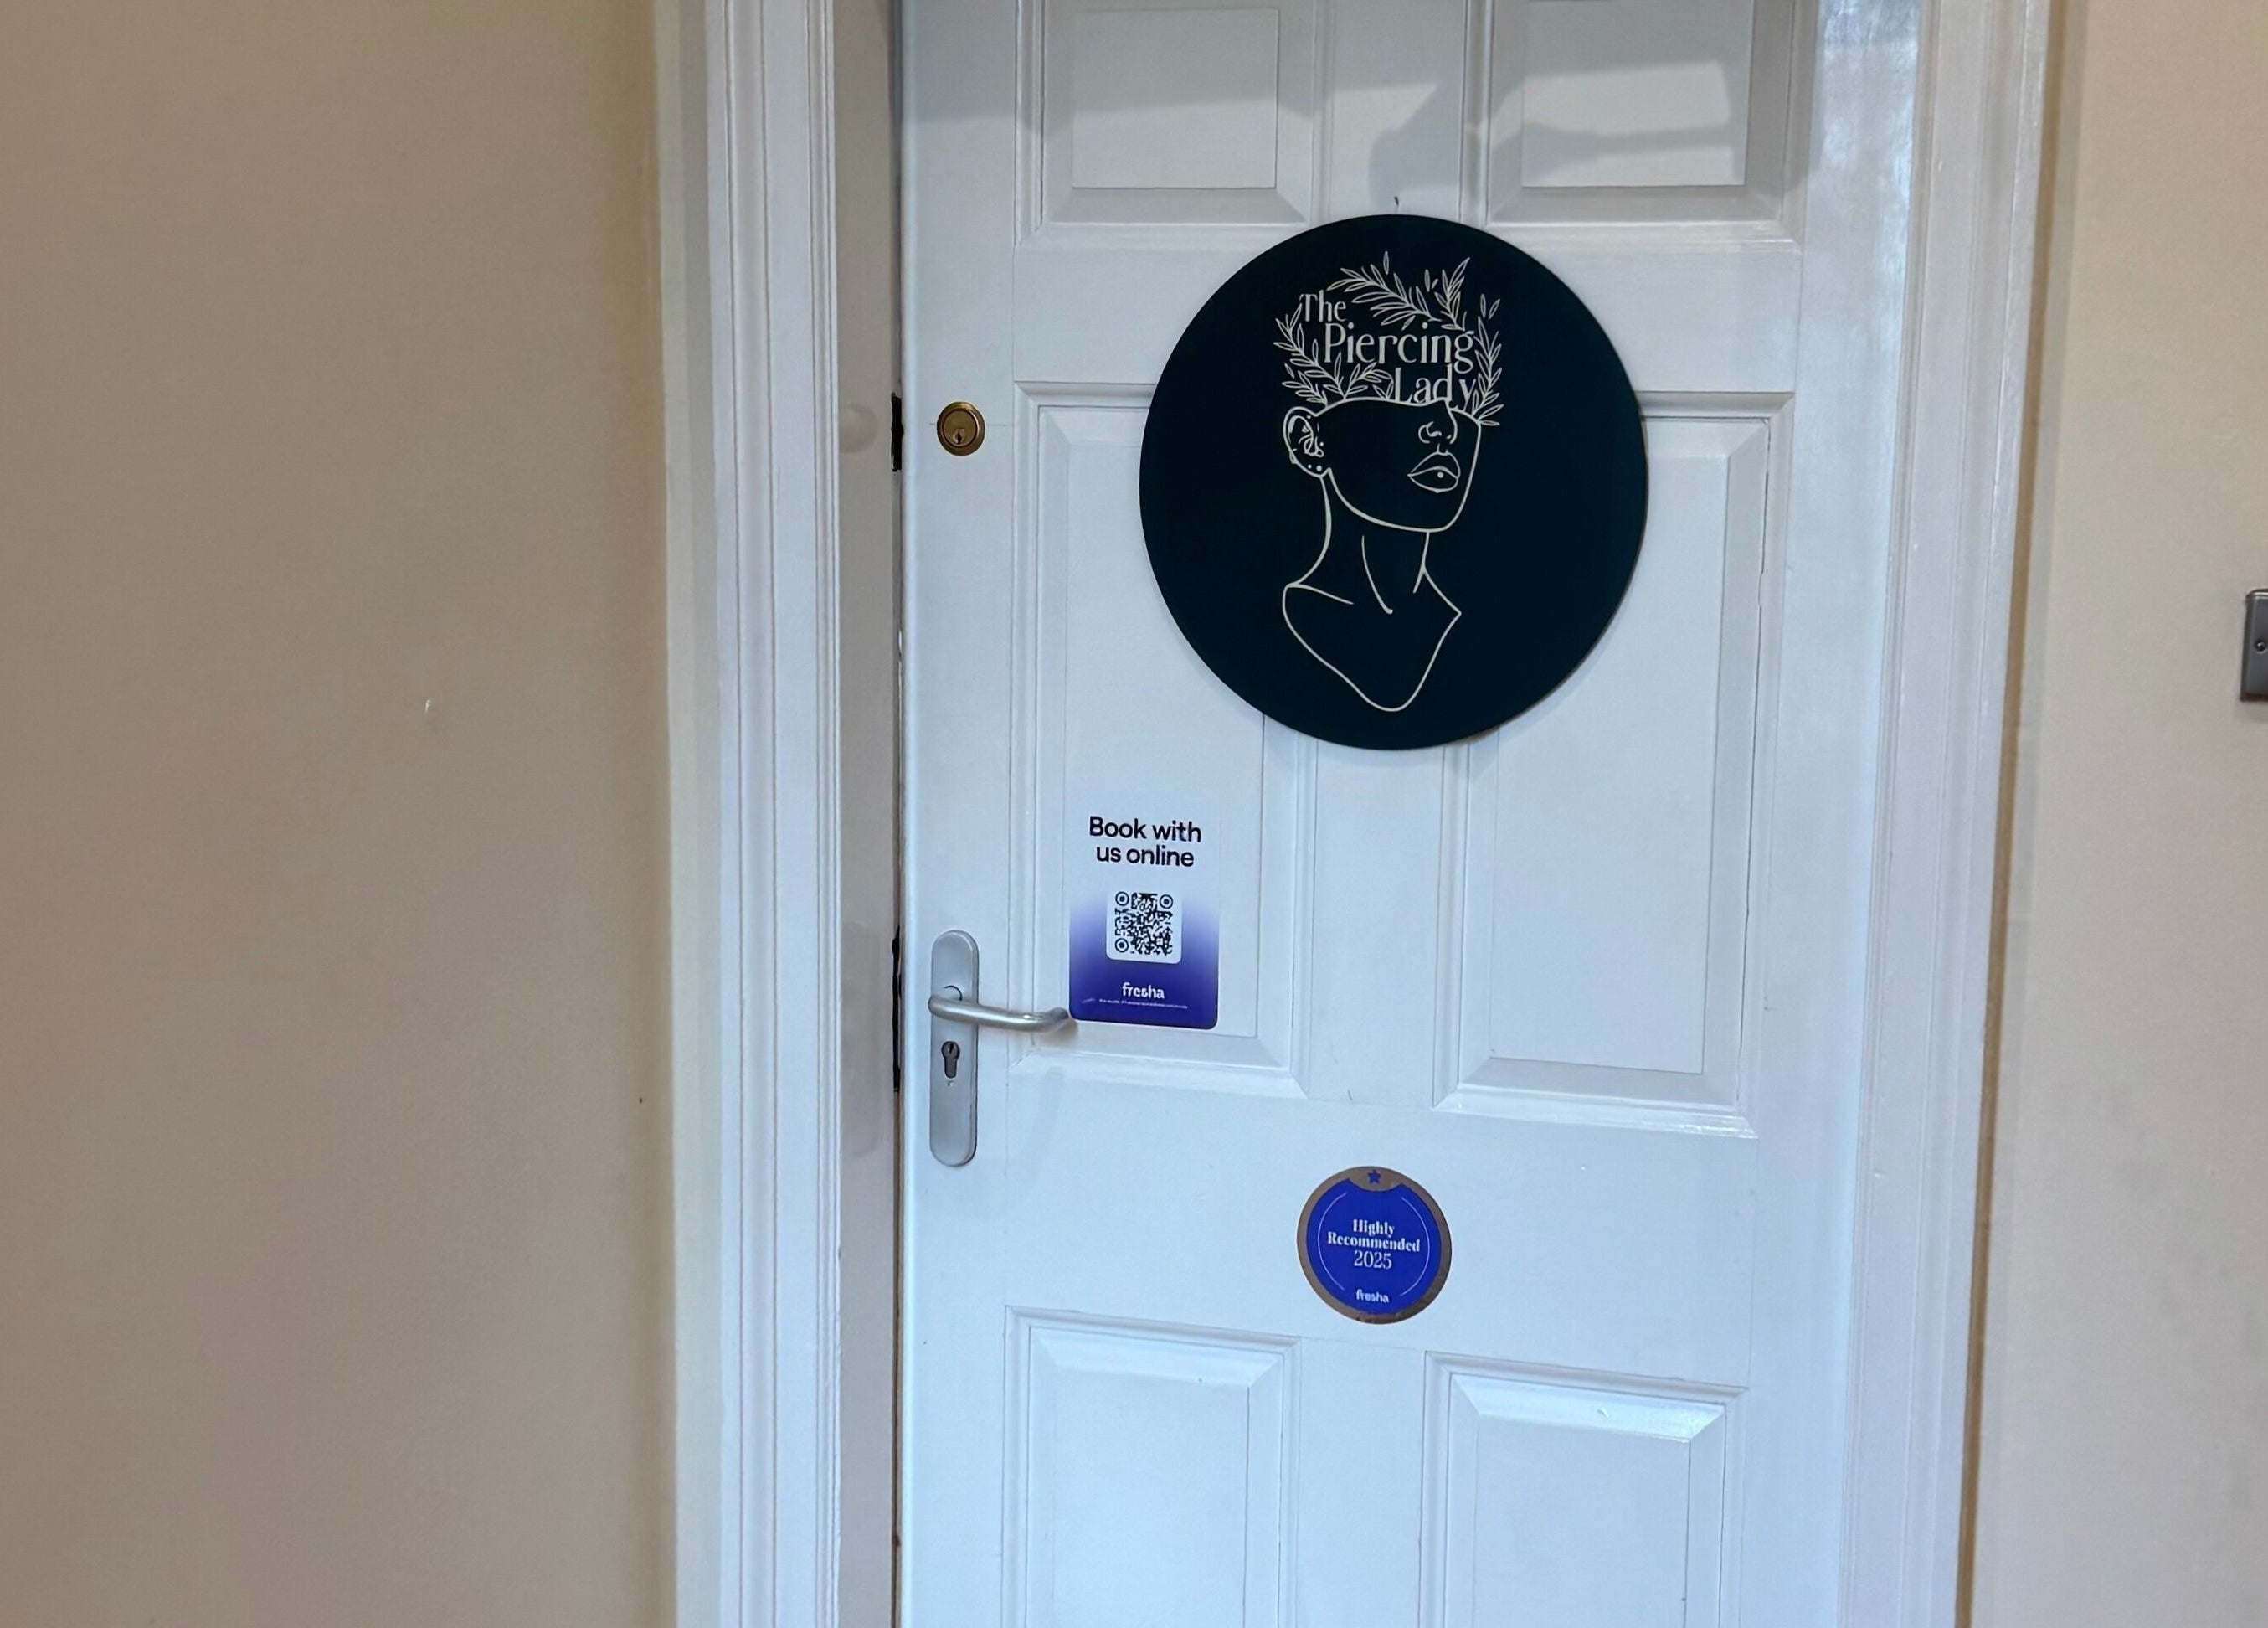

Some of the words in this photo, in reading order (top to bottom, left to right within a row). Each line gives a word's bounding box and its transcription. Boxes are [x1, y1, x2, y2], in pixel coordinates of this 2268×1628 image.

[1299, 290, 1346, 322] The
[1324, 322, 1474, 374] Piercing
[1395, 363, 1476, 410] Lady
[1089, 816, 1147, 840] Book
[1152, 820, 1201, 842] with
[1096, 846, 1121, 863] us
[1126, 844, 1194, 867] online
[1122, 981, 1165, 999] fresha
[1352, 1218, 1395, 1238] Highly
[1327, 1231, 1421, 1252] Recommended
[1354, 1250, 1392, 1270] 2025
[1355, 1288, 1390, 1303] fresha
